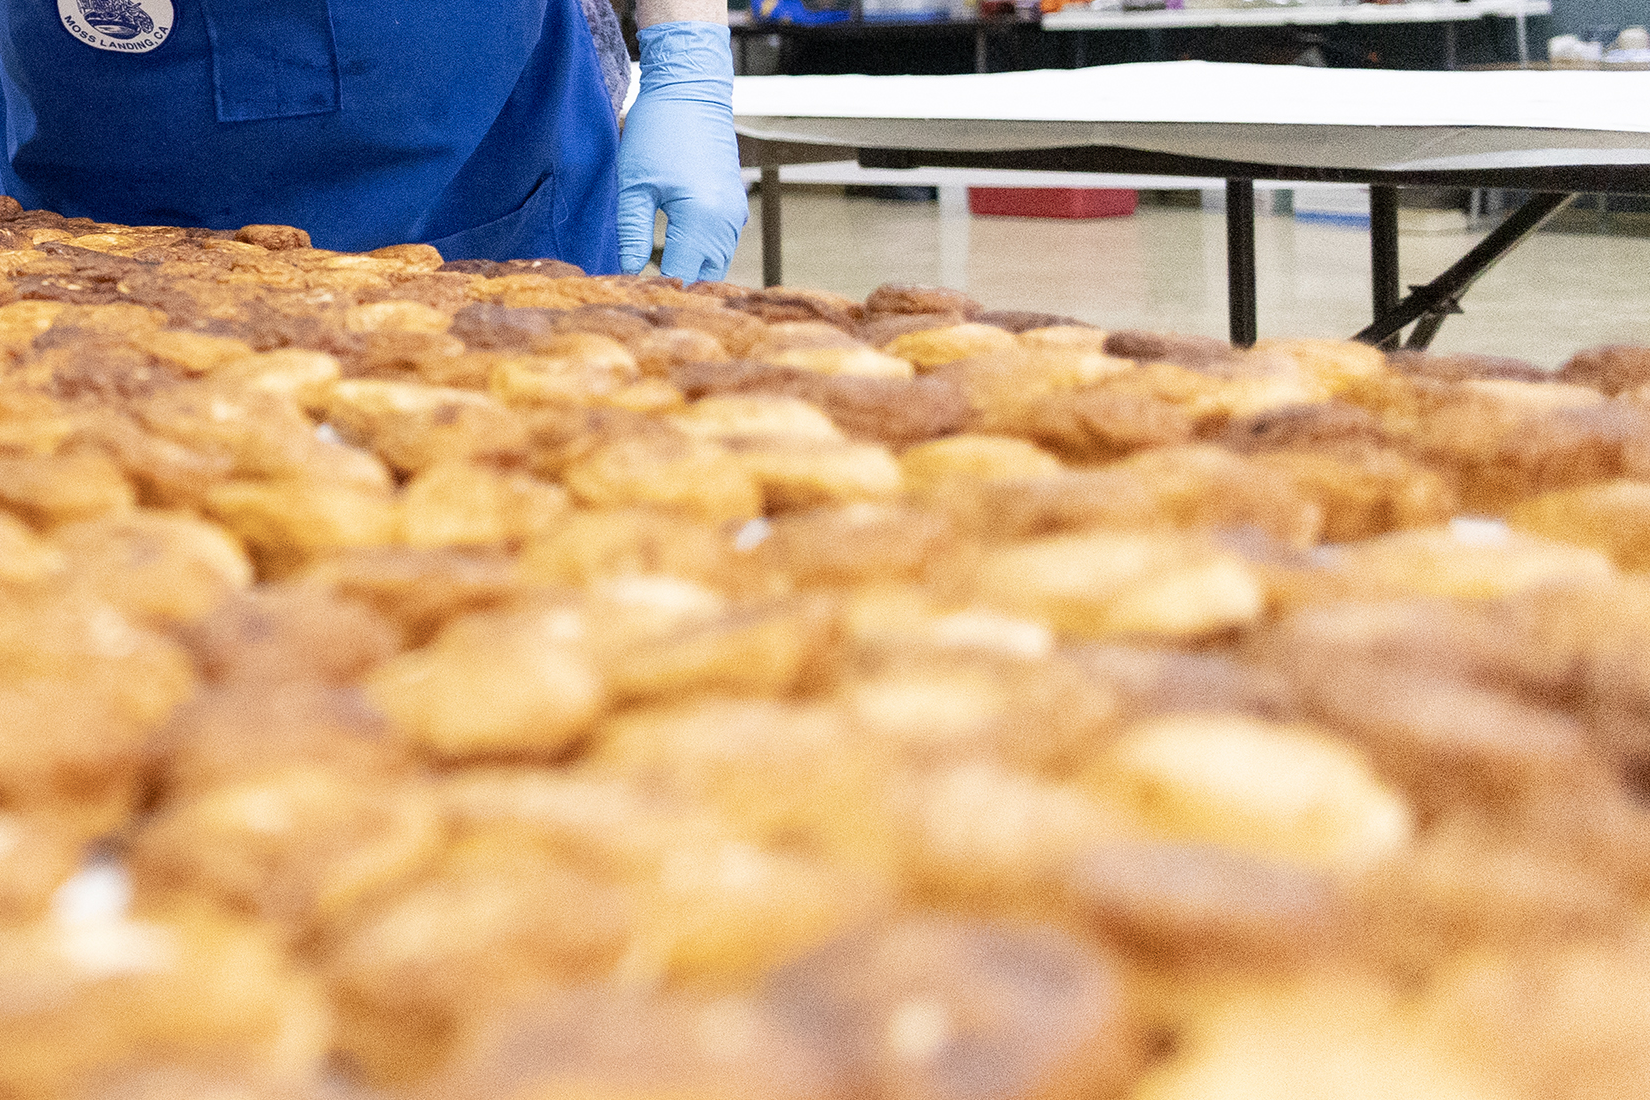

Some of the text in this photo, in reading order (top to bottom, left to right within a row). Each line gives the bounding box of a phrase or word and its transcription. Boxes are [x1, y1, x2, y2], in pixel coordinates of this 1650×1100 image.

[64, 15, 169, 50] MOSS LANDING, CA
